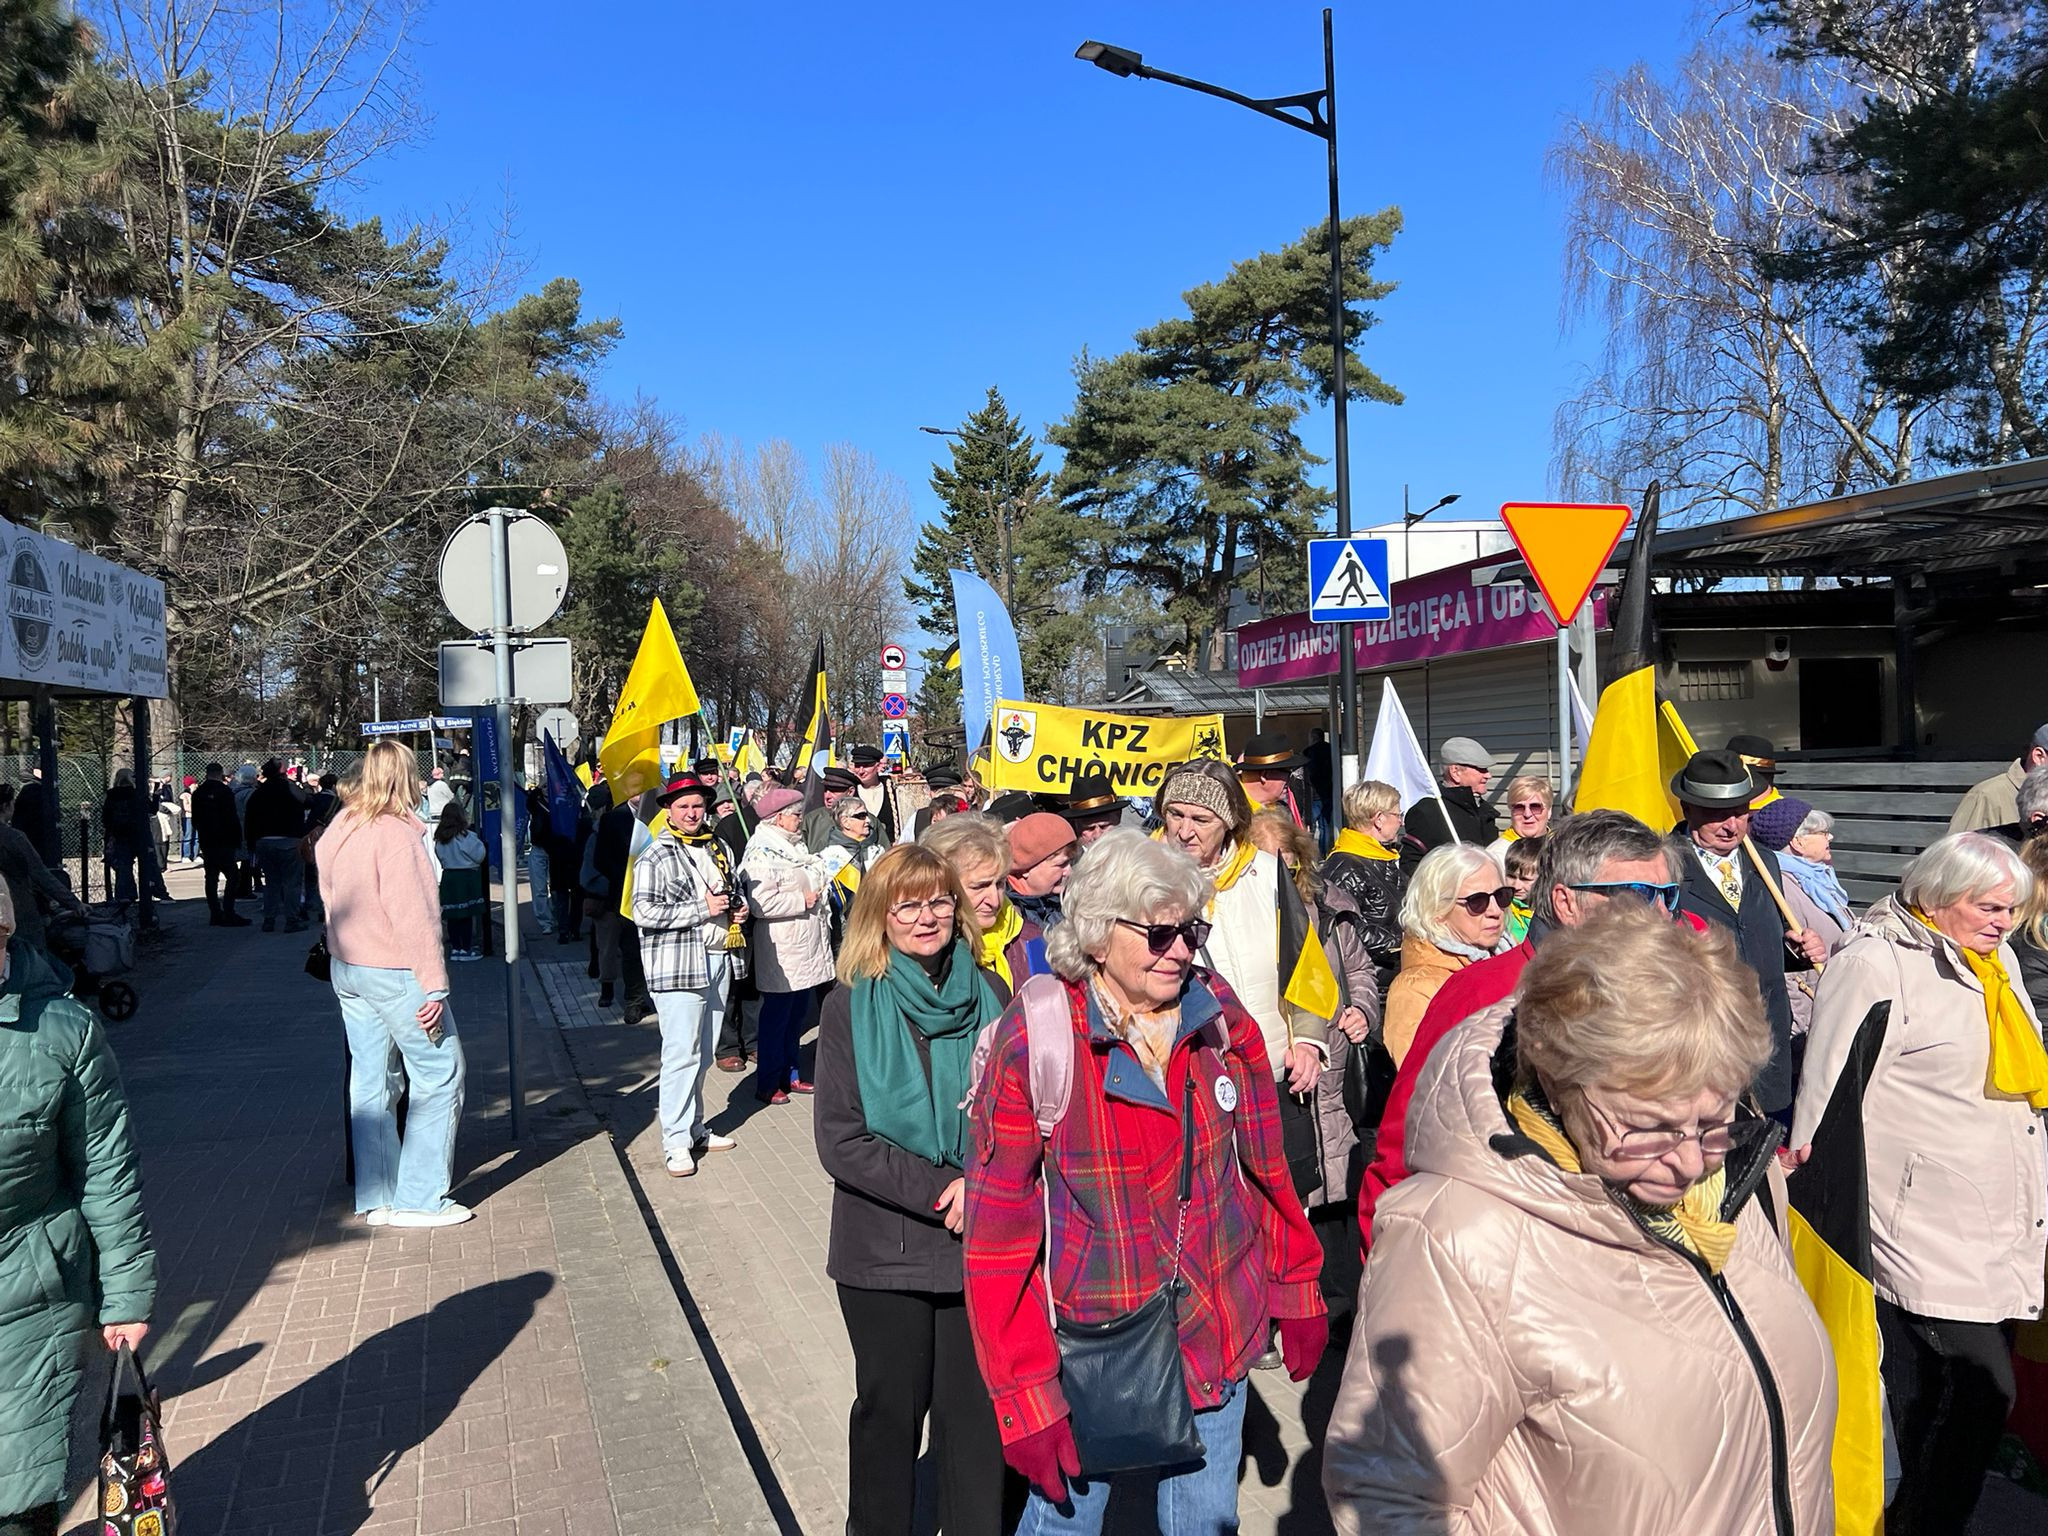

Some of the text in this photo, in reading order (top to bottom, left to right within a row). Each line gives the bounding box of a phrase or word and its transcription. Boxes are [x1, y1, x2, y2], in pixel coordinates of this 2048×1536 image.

[58, 559, 107, 606] Naleśniki
[57, 629, 88, 664] Bubble
[1241, 627, 1287, 671] ODZIEŻ
[1366, 590, 1472, 646] DZIECIĘCA
[1476, 586, 1484, 624] I
[1082, 719, 1150, 753] KPZ
